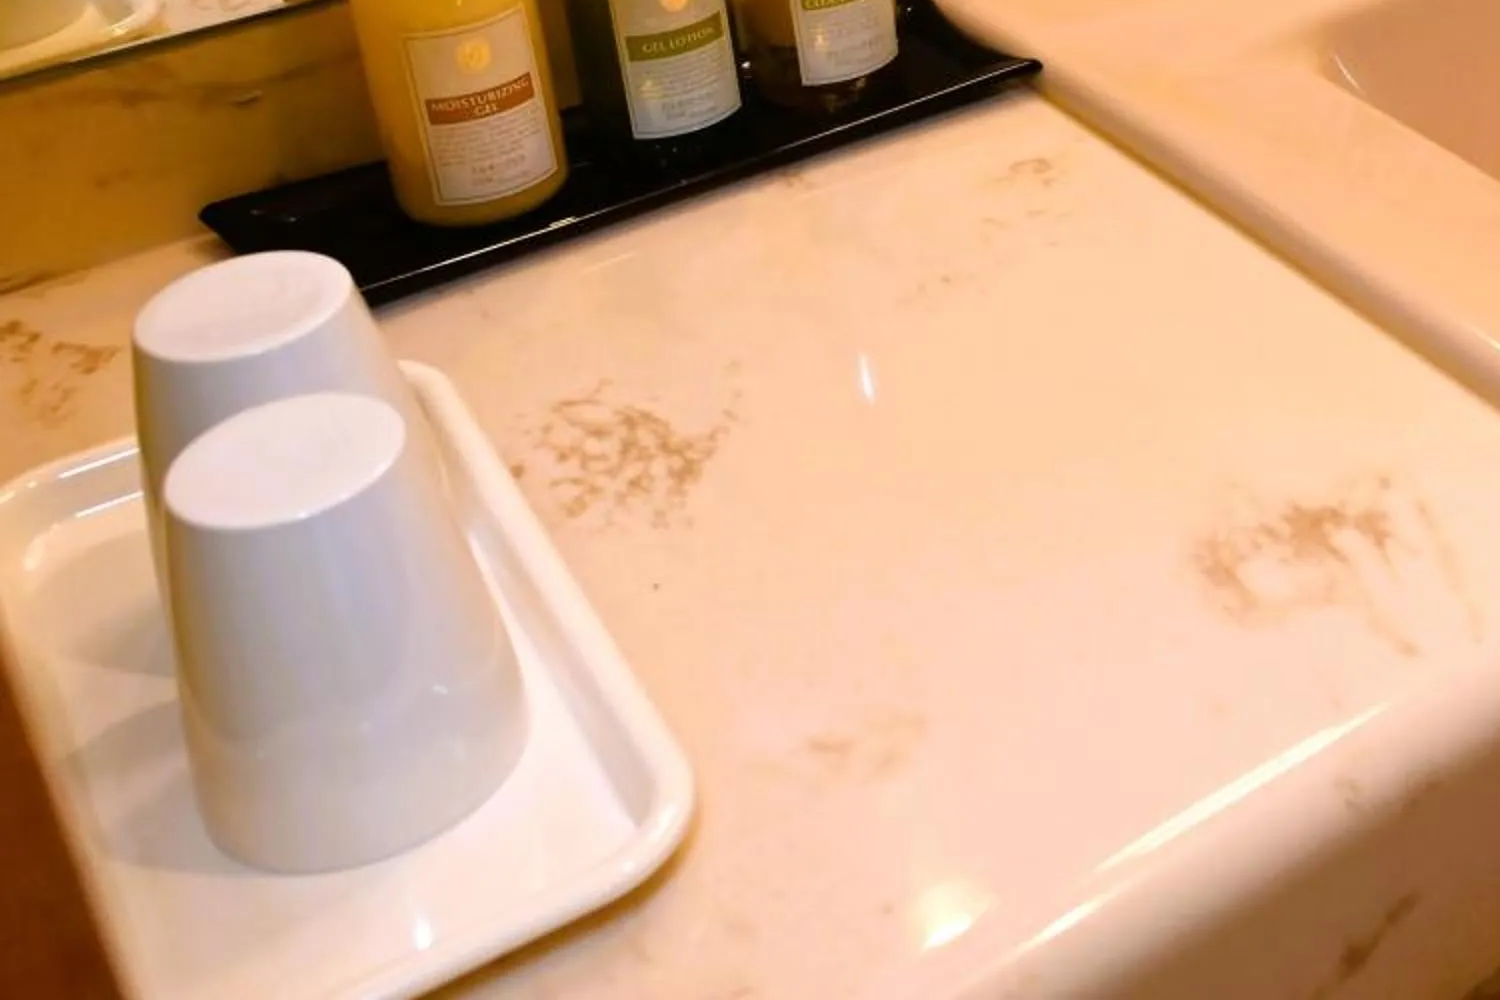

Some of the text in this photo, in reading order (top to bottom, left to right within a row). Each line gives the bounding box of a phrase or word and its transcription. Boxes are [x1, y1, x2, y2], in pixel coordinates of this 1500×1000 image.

[642, 41, 667, 53] GEL
[430, 76, 530, 112] MOISTURIZING
[473, 104, 498, 117] GEL
